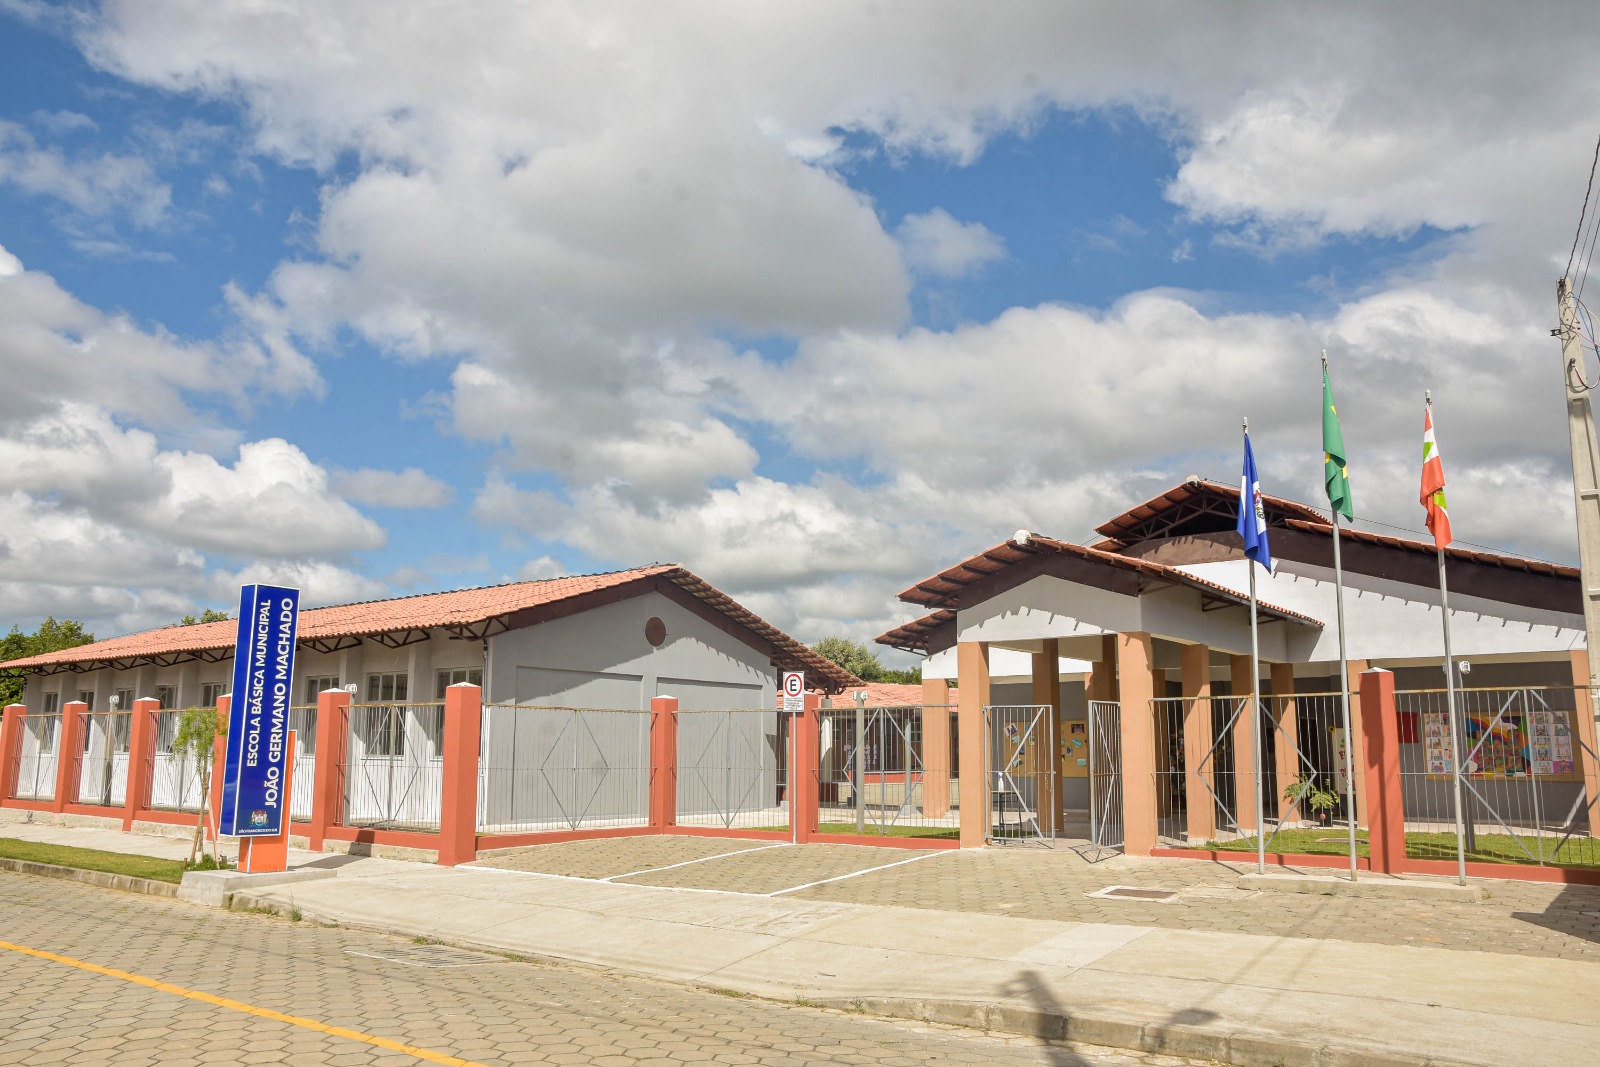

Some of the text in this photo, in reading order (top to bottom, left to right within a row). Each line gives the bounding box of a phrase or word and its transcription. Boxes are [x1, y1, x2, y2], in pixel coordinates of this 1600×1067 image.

[246, 599, 271, 767] ESCOLA BÁSICA MUNICIPAL
[264, 597, 293, 809] JOÃO GERMANO MACHADO
[790, 679, 797, 691] E
